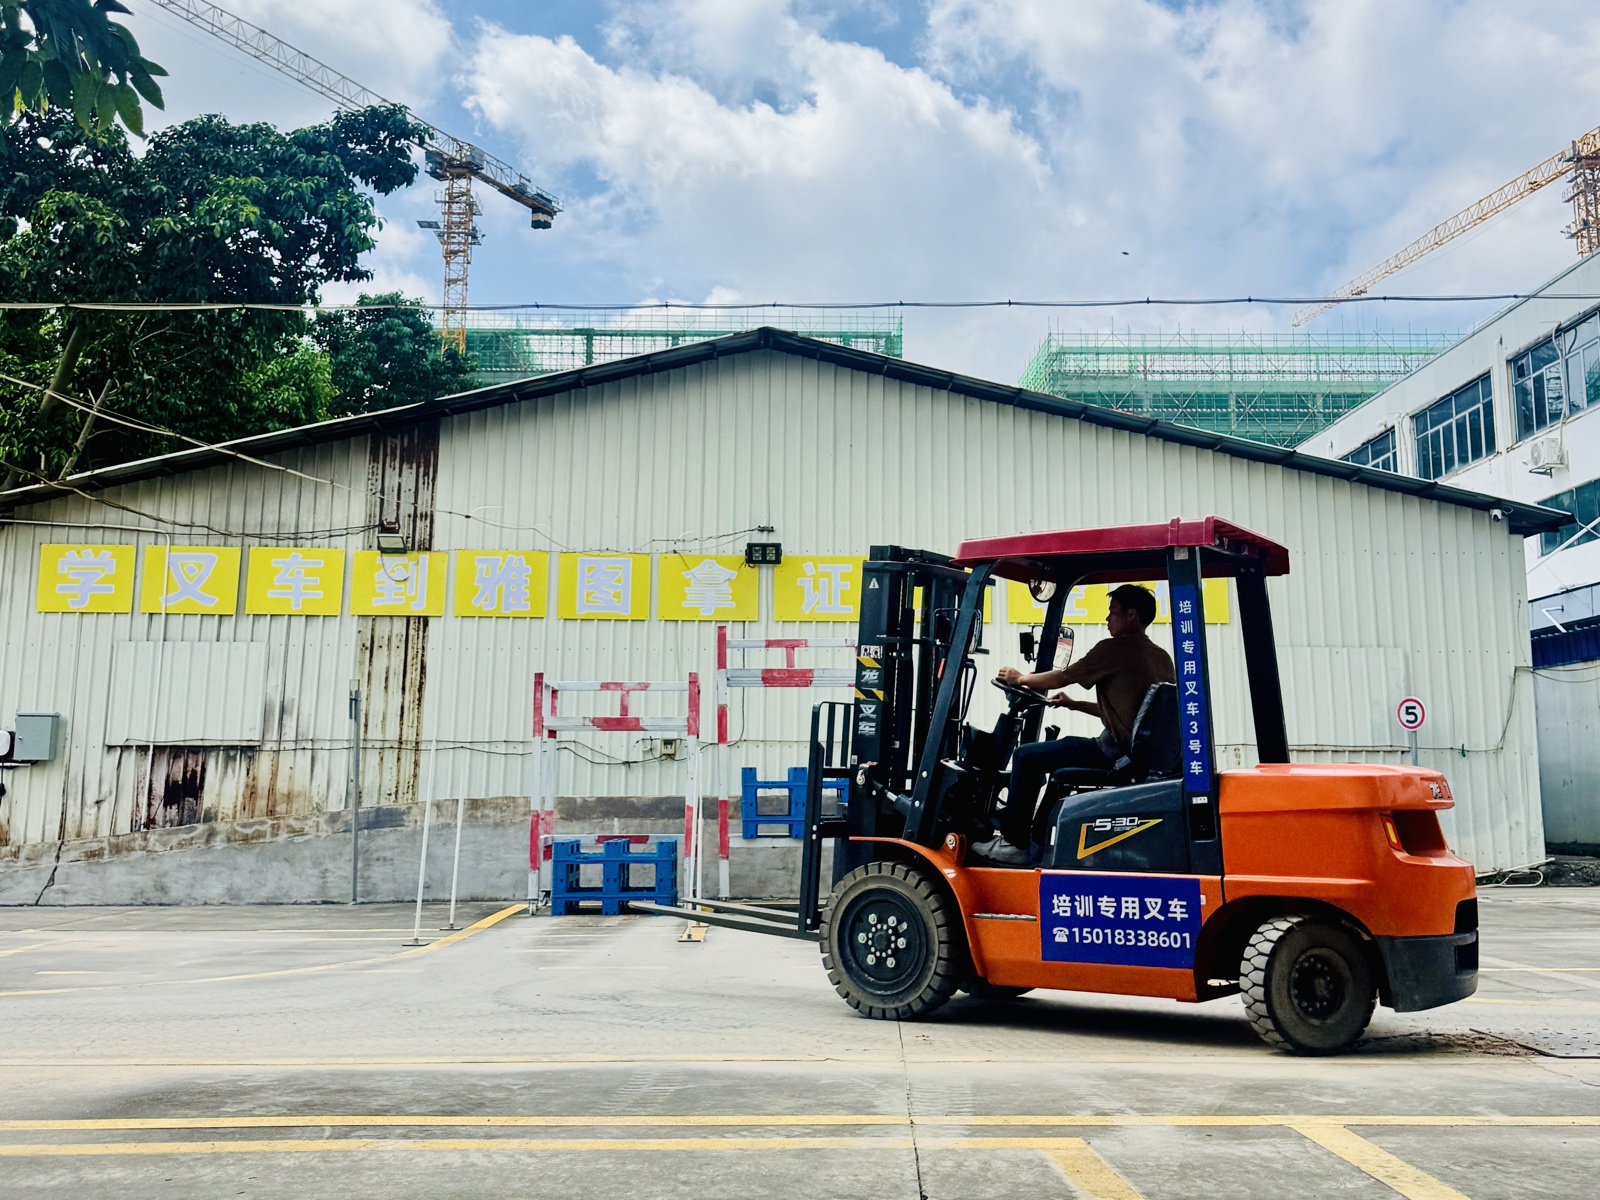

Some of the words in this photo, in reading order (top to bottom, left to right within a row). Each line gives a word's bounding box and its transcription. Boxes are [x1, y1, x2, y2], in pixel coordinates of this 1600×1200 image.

[56, 548, 1207, 617] 学叉车到雅图拿证
[1178, 600, 1203, 776] 培训专用叉车3号车
[1405, 705, 1418, 724] 5
[1052, 894, 1189, 921] 培训专用叉车
[1072, 927, 1191, 949] 15018338601
